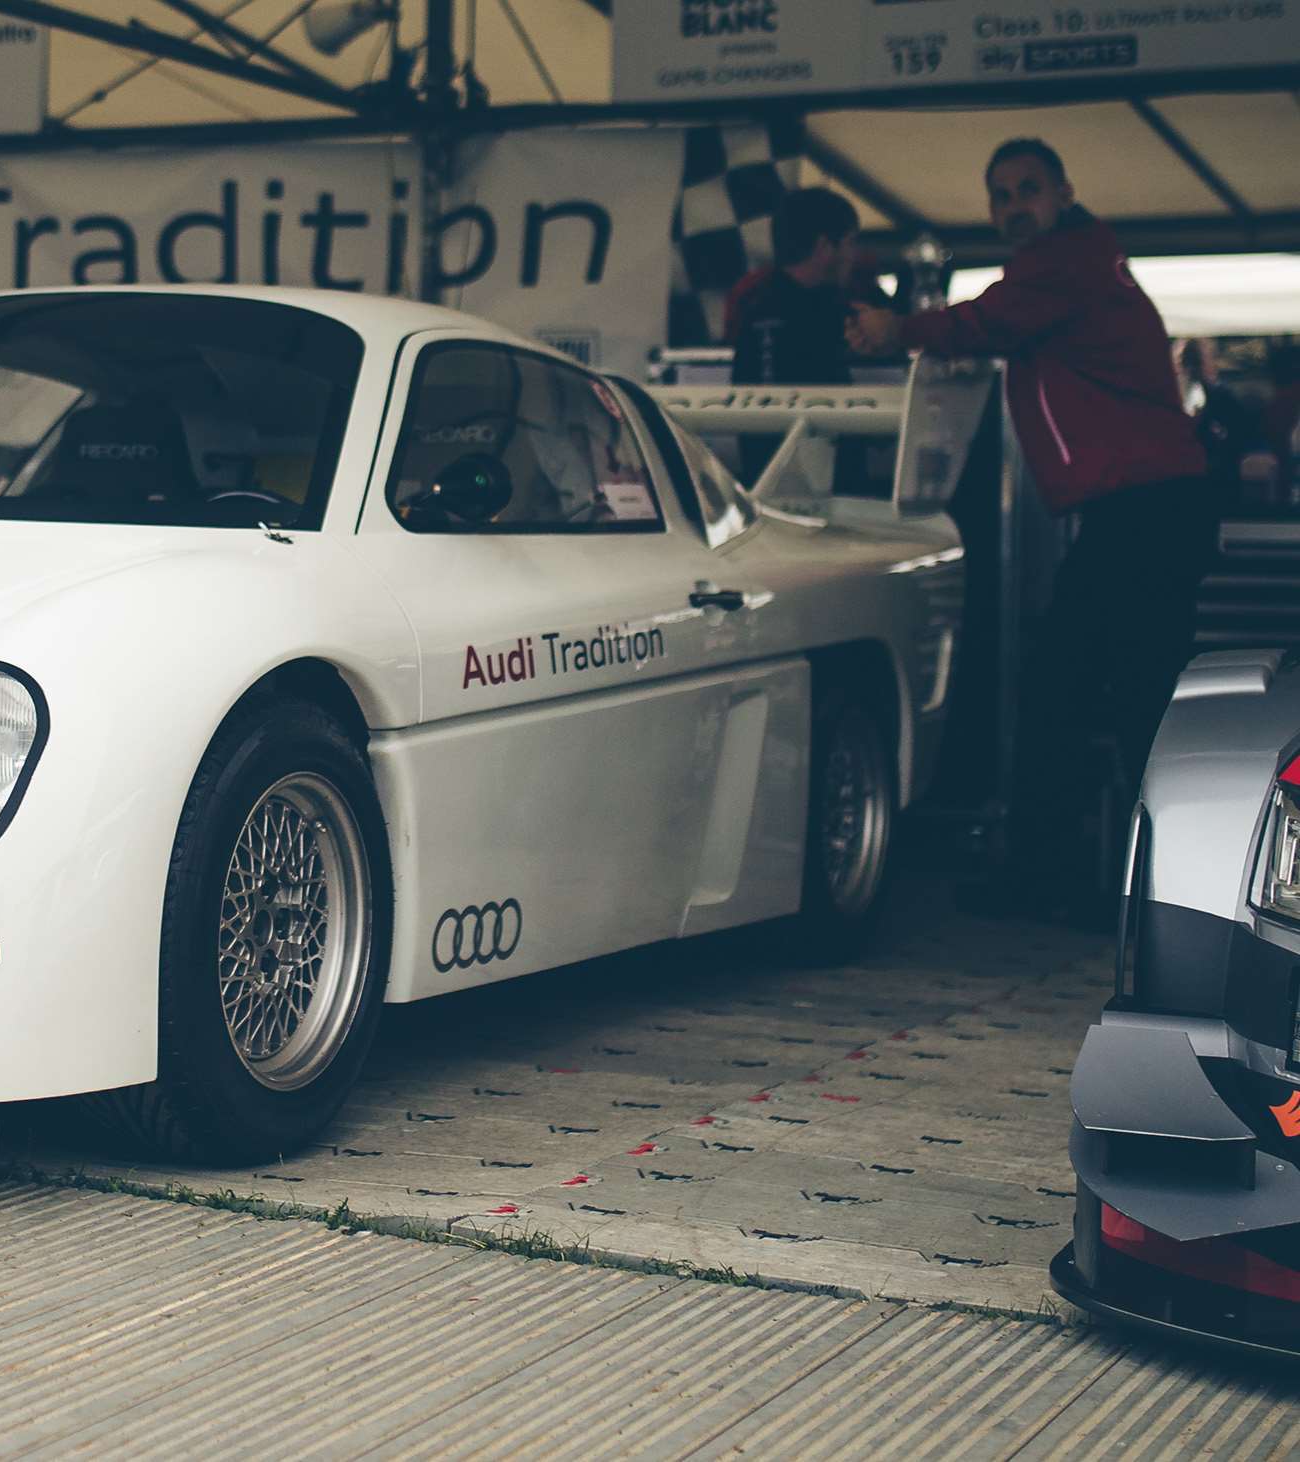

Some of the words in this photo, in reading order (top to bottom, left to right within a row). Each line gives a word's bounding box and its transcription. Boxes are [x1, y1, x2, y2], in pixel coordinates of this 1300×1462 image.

[681, 8, 777, 37] BLANC
[463, 637, 536, 690] Audi
[541, 621, 665, 675] Tradition
